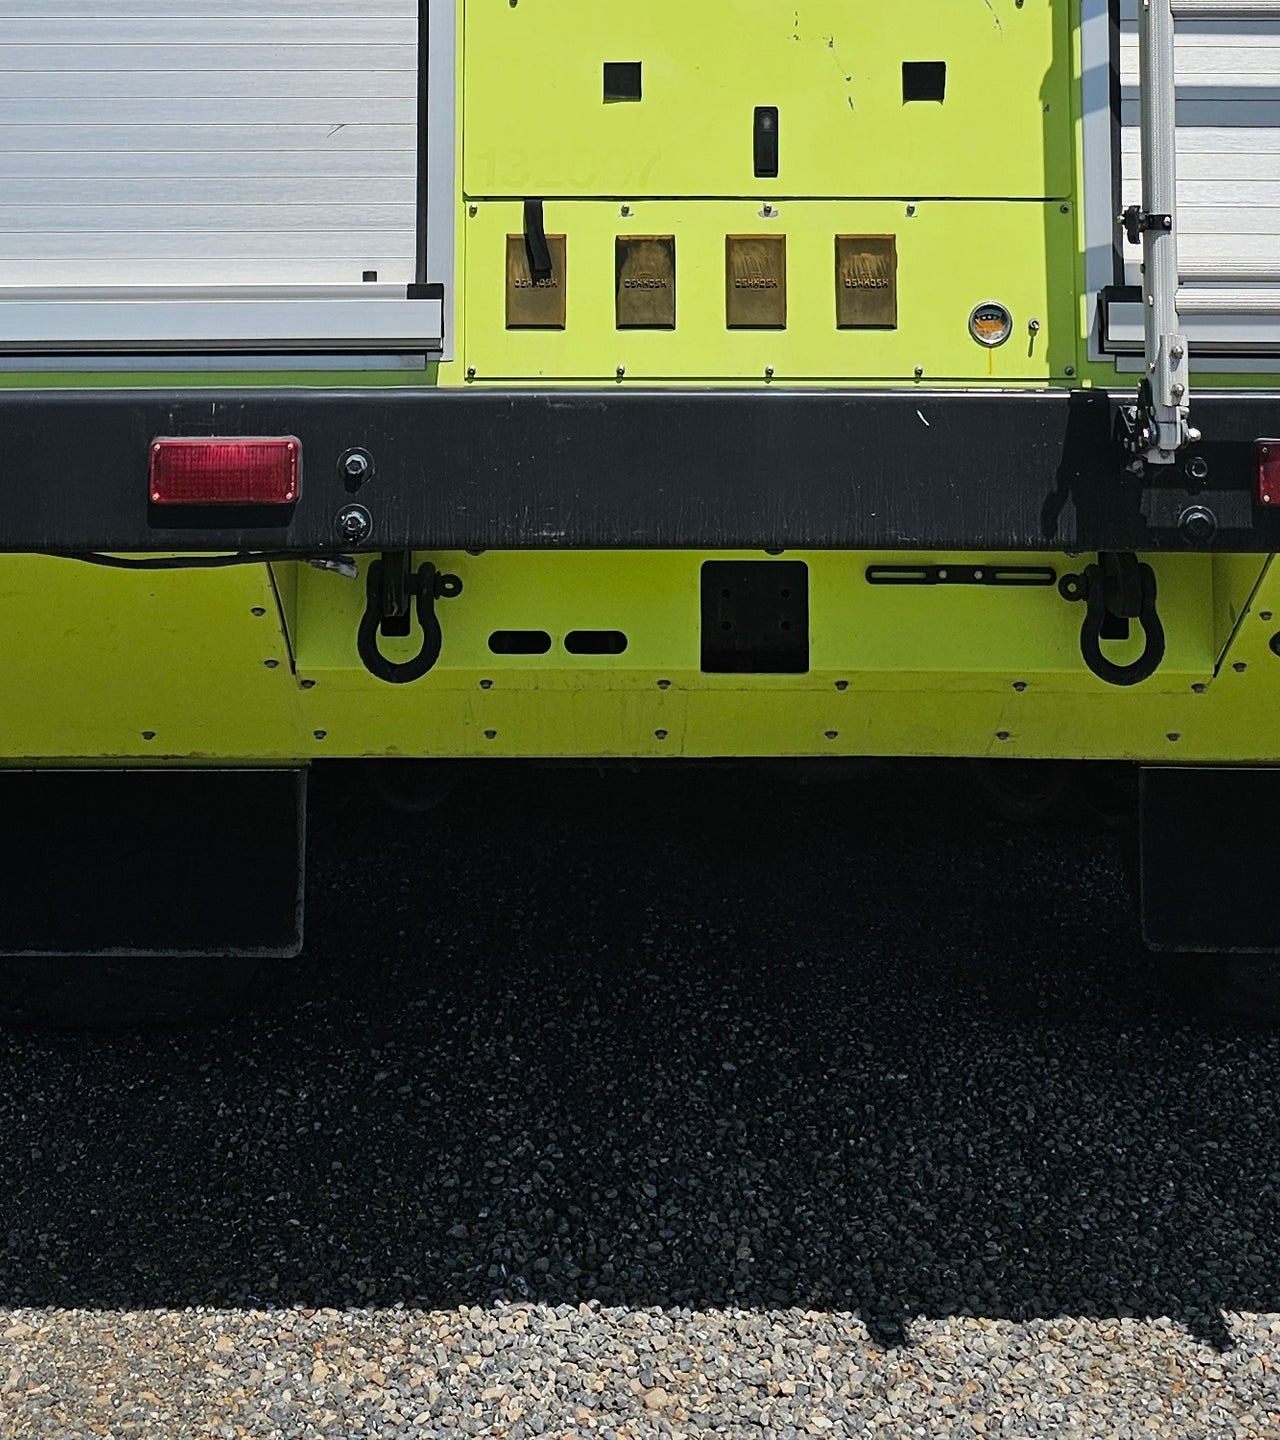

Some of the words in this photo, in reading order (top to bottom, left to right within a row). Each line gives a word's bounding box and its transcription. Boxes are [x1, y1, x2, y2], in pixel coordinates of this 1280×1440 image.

[624, 278, 667, 289] OSHKOSH
[735, 278, 778, 289] OSHKOSH
[845, 278, 889, 289] OSHKOSH
